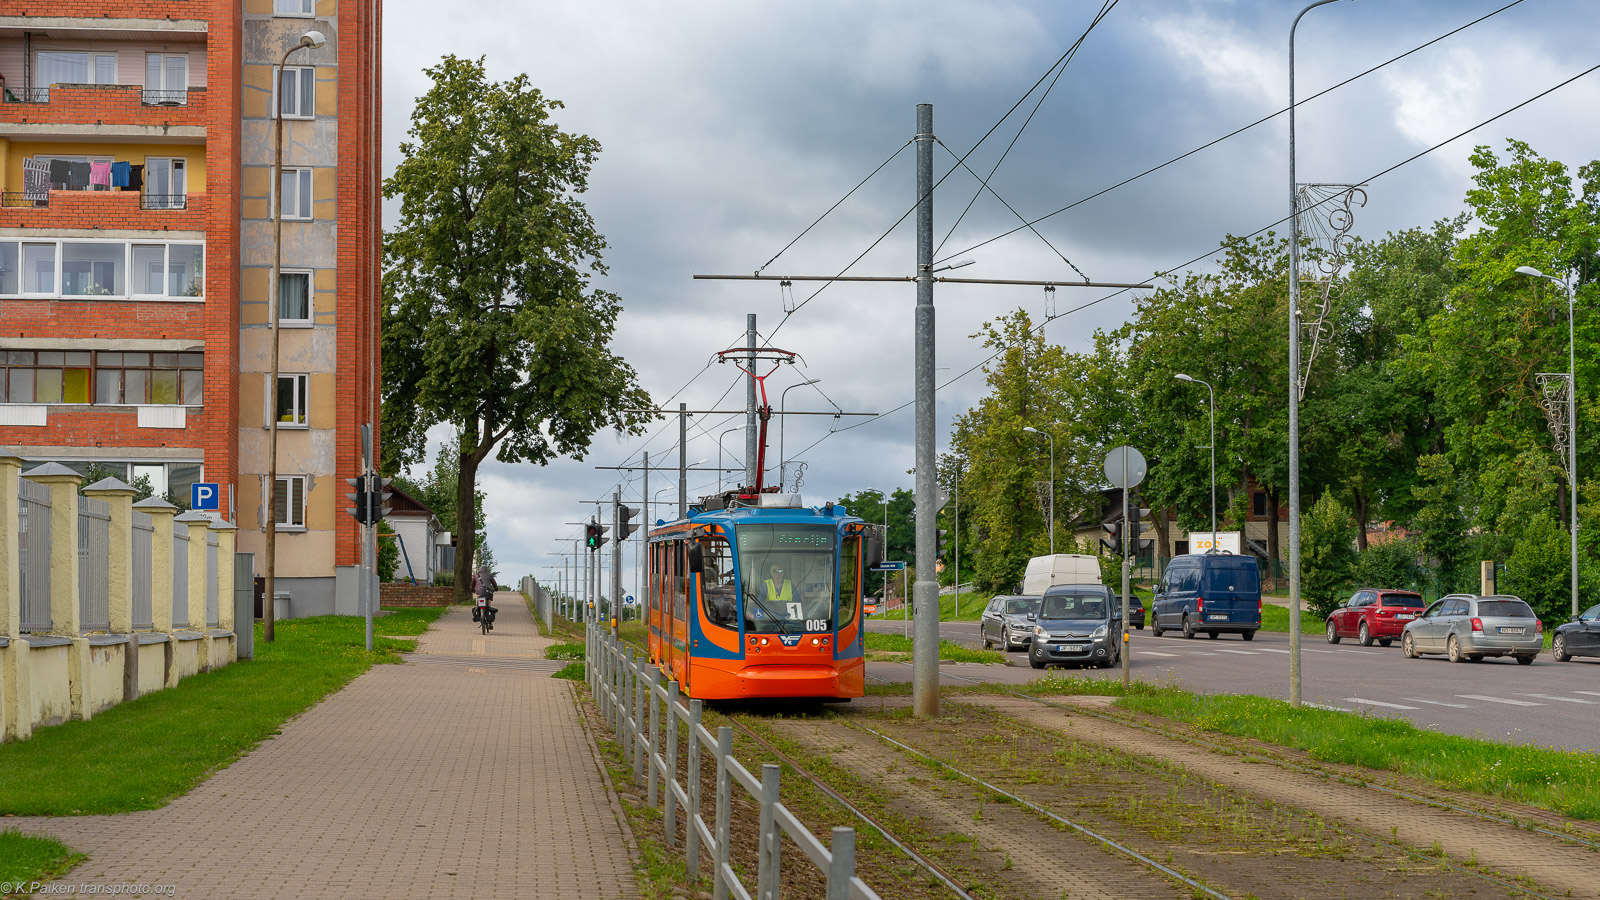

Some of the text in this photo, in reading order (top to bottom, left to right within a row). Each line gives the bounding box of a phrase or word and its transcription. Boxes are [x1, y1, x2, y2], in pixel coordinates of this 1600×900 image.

[198, 486, 213, 507] P
[790, 603, 799, 619] 1
[805, 619, 828, 632] 005
